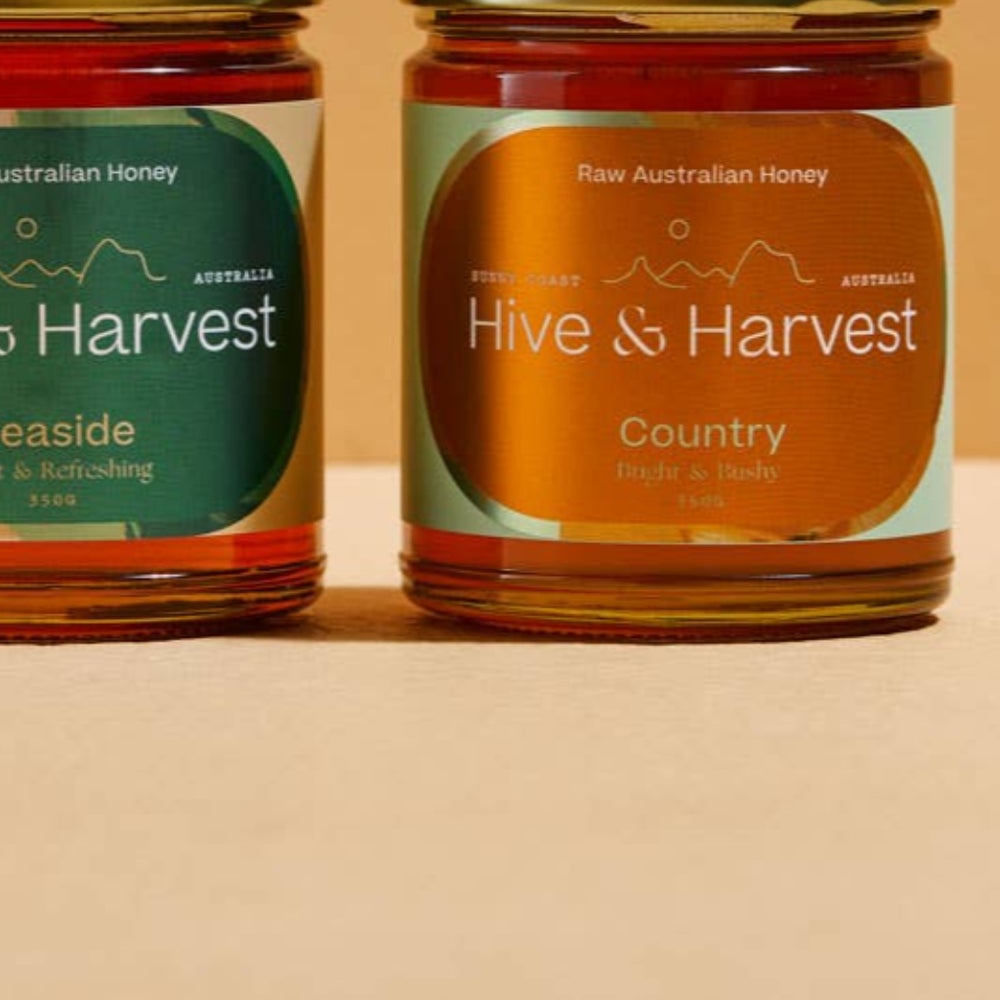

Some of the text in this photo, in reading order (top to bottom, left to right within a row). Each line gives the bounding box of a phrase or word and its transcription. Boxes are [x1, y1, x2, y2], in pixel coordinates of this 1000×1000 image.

[107, 163, 179, 185] Honey
[578, 164, 829, 187] Raw Australian Honey
[193, 268, 275, 285] AUSTRALIA
[841, 272, 916, 287] AUSTRALIA
[38, 294, 277, 356] Harvest
[469, 296, 917, 357] Hive & Harvest
[619, 416, 786, 455] Country
[13, 460, 33, 480] &
[40, 458, 154, 484] Refreshing
[718, 460, 779, 484] Bushy
